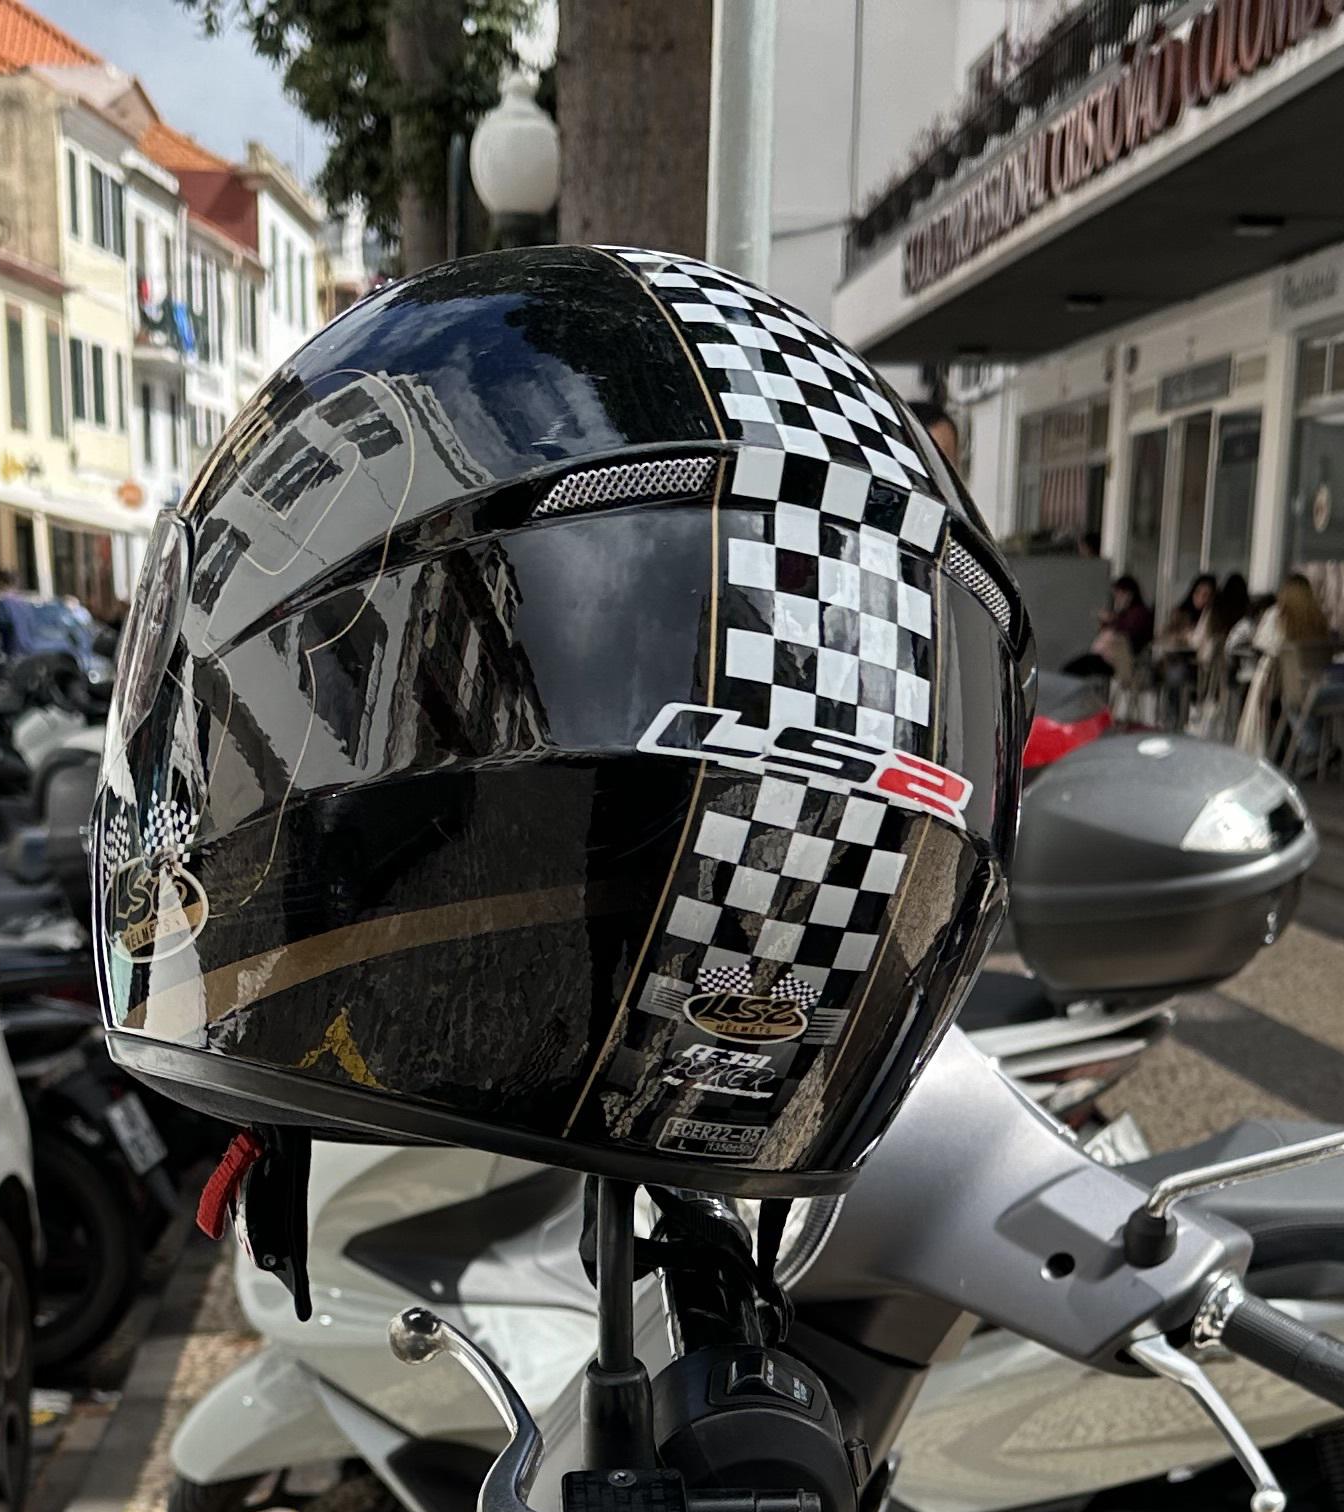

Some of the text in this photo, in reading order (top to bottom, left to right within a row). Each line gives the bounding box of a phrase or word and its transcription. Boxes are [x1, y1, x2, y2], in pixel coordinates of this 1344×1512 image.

[636, 702, 973, 830] LS2
[696, 993, 797, 1024] LS2
[716, 1024, 772, 1034] HELMETS
